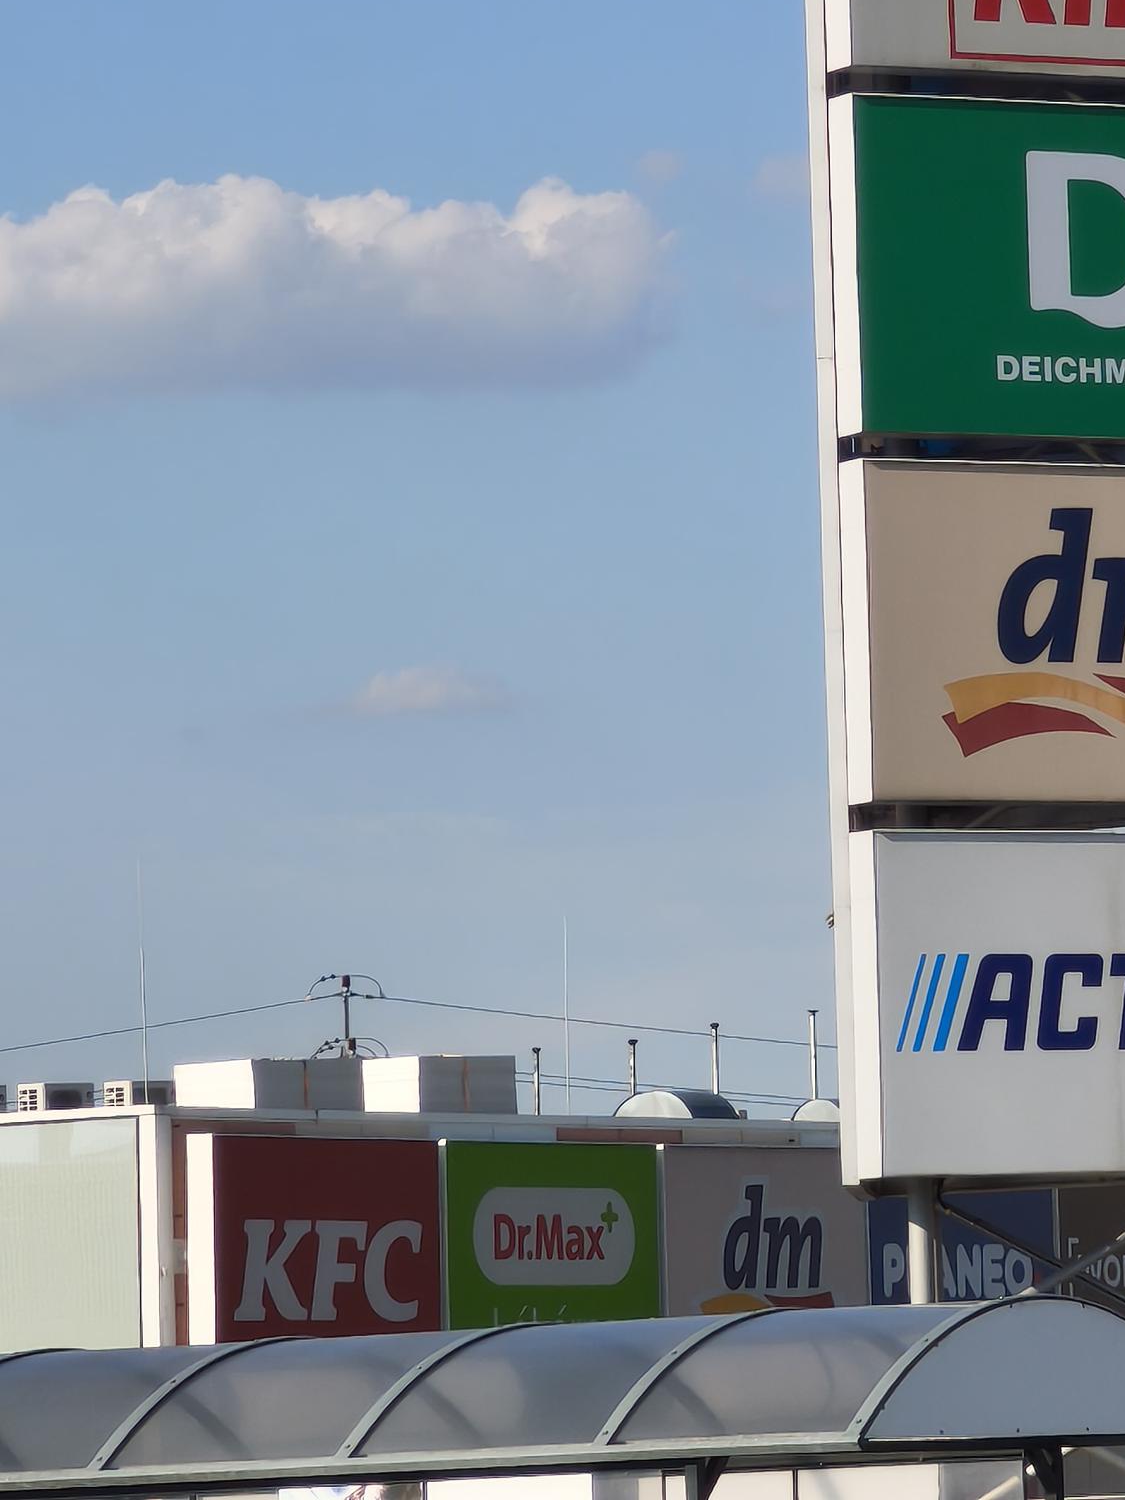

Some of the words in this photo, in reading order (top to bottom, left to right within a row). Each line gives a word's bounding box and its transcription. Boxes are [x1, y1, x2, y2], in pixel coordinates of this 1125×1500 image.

[233, 1218, 424, 1322] KFC
[493, 1213, 605, 1261] Dr.Max
[722, 1184, 823, 1290] dm
[883, 1243, 1034, 1299] PANEO
